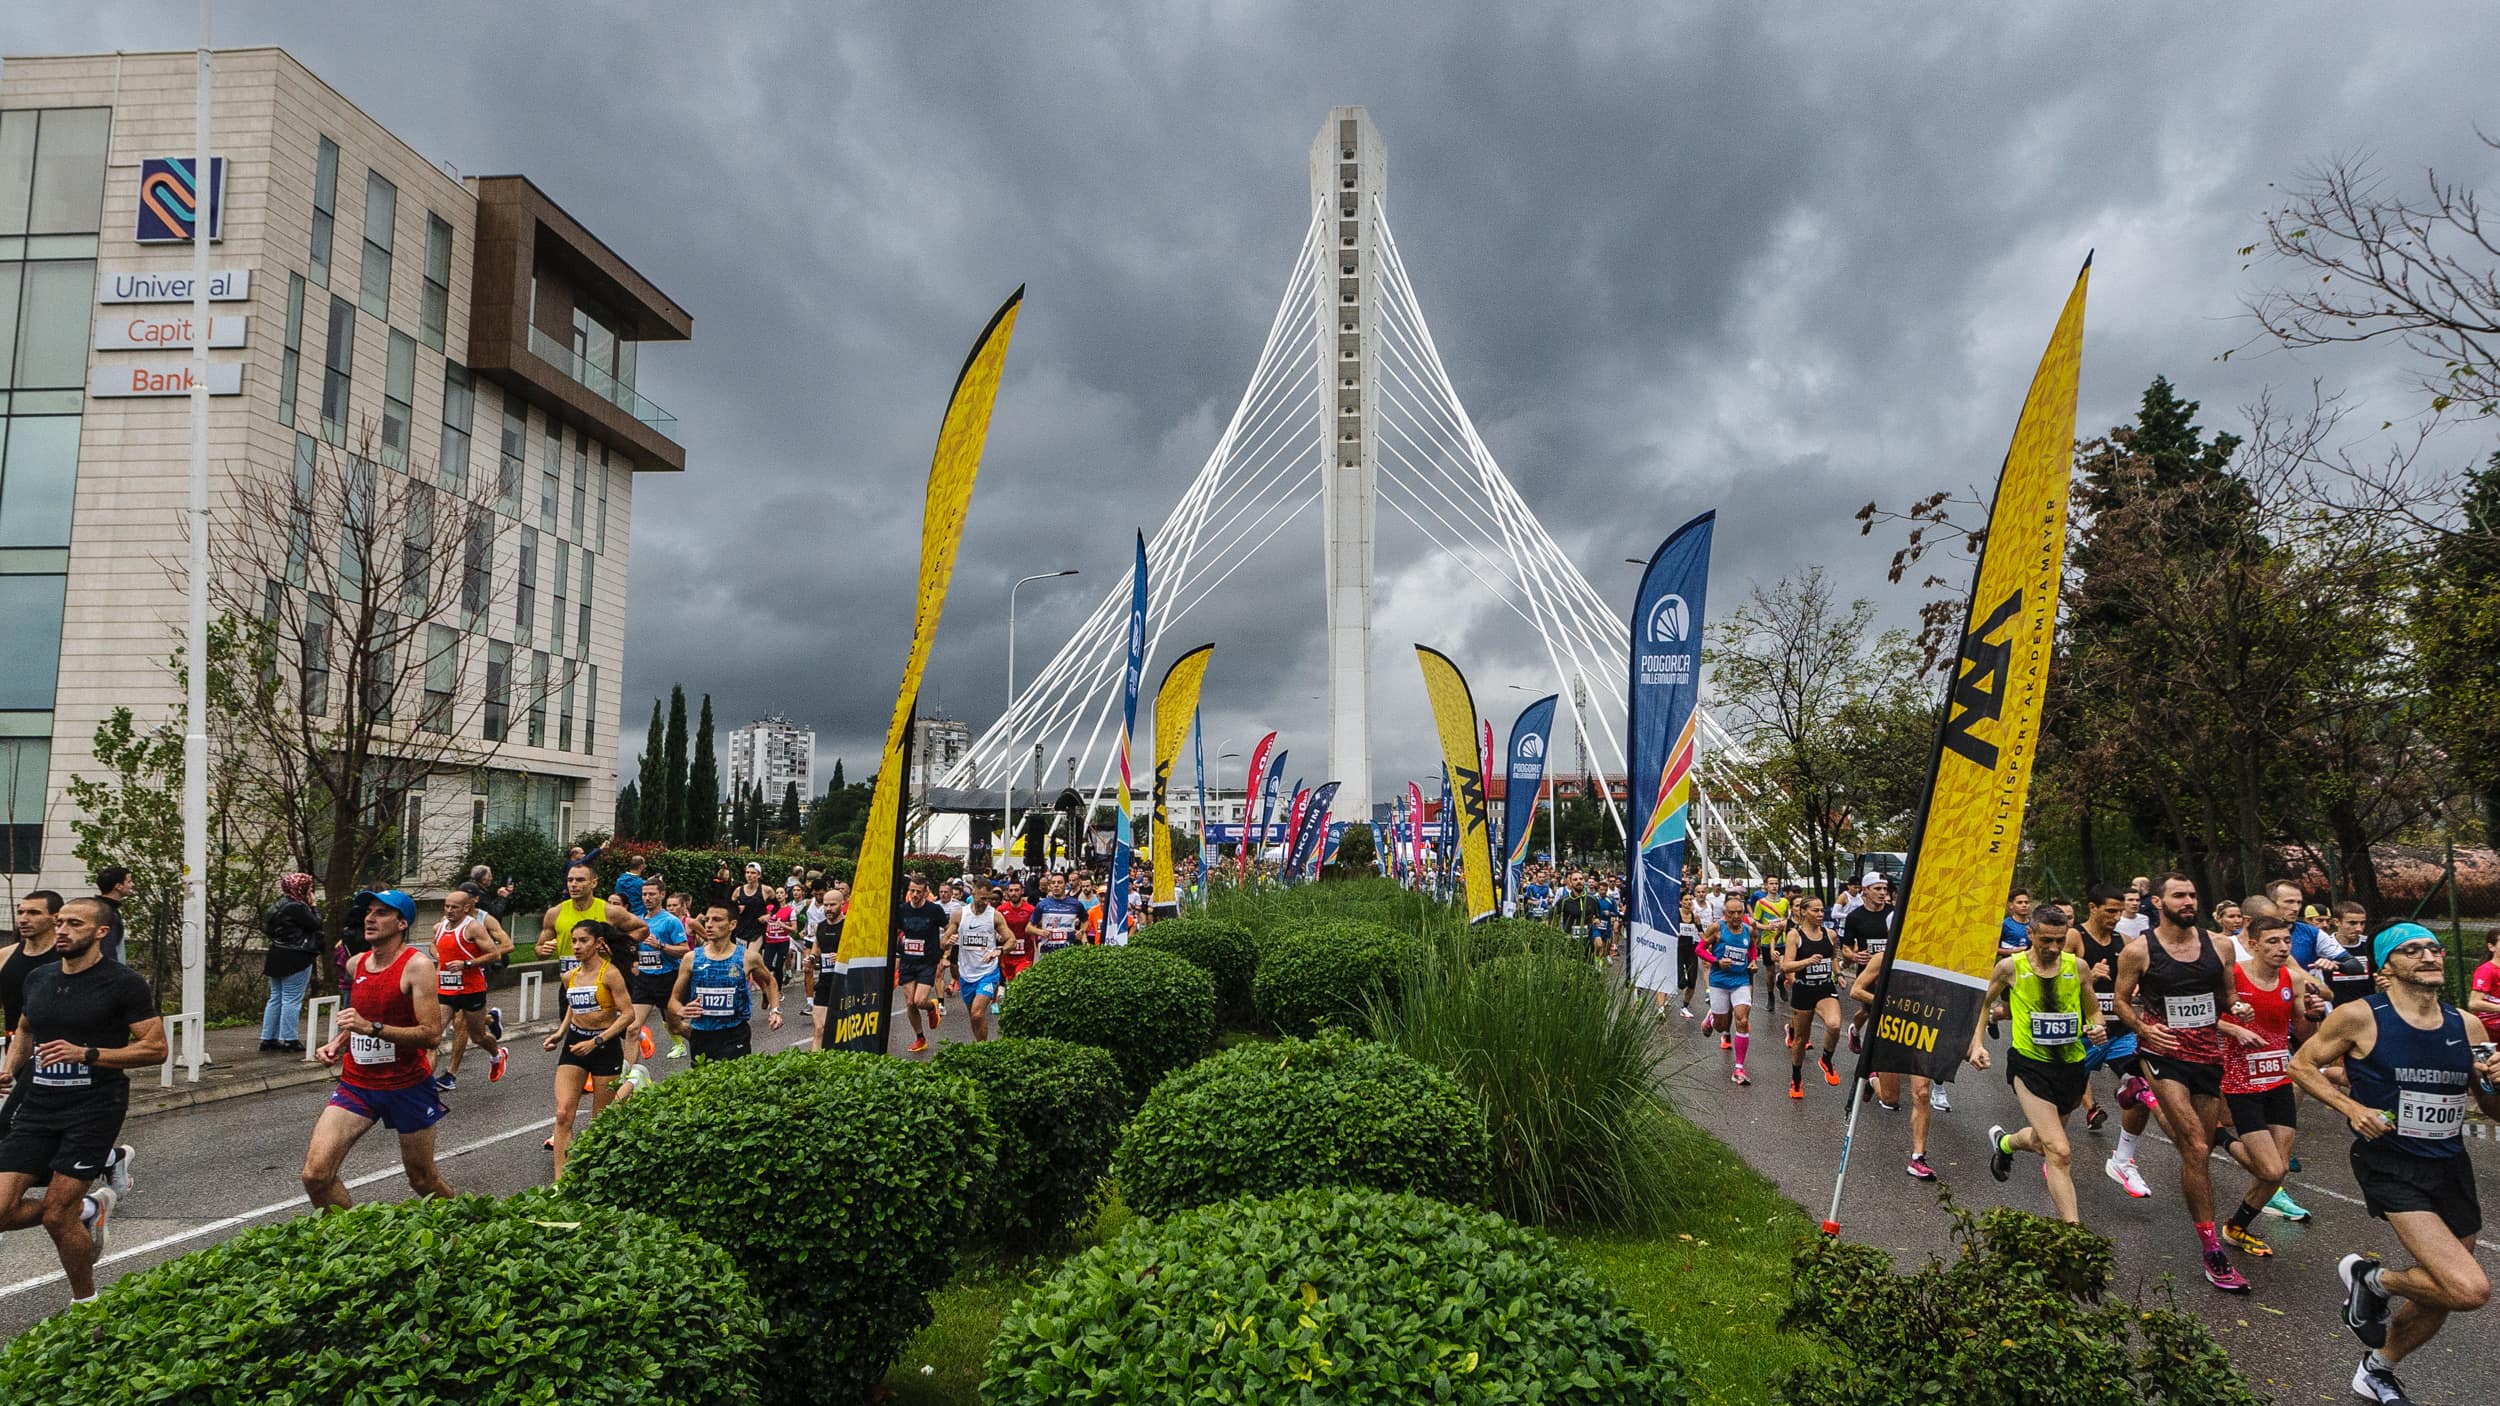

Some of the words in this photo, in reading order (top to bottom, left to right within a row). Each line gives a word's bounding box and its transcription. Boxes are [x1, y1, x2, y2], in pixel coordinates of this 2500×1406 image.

[115, 273, 231, 298] Univeral
[128, 318, 213, 346] Capitl
[132, 369, 195, 391] Bank
[1641, 655, 1691, 672] PODGORICA
[1989, 718, 2028, 854] MULTISPORT
[2025, 580, 2048, 706] AKADEMIJA
[2041, 499, 2055, 572] MAYER
[571, 993, 589, 1005] 1009
[705, 995, 725, 1006] 1127
[2178, 1004, 2206, 1017] 1202
[2044, 1022, 2067, 1034] 763
[357, 1038, 381, 1051] 1194
[2258, 1060, 2280, 1073] 586
[2416, 1105, 2456, 1124] 1200
